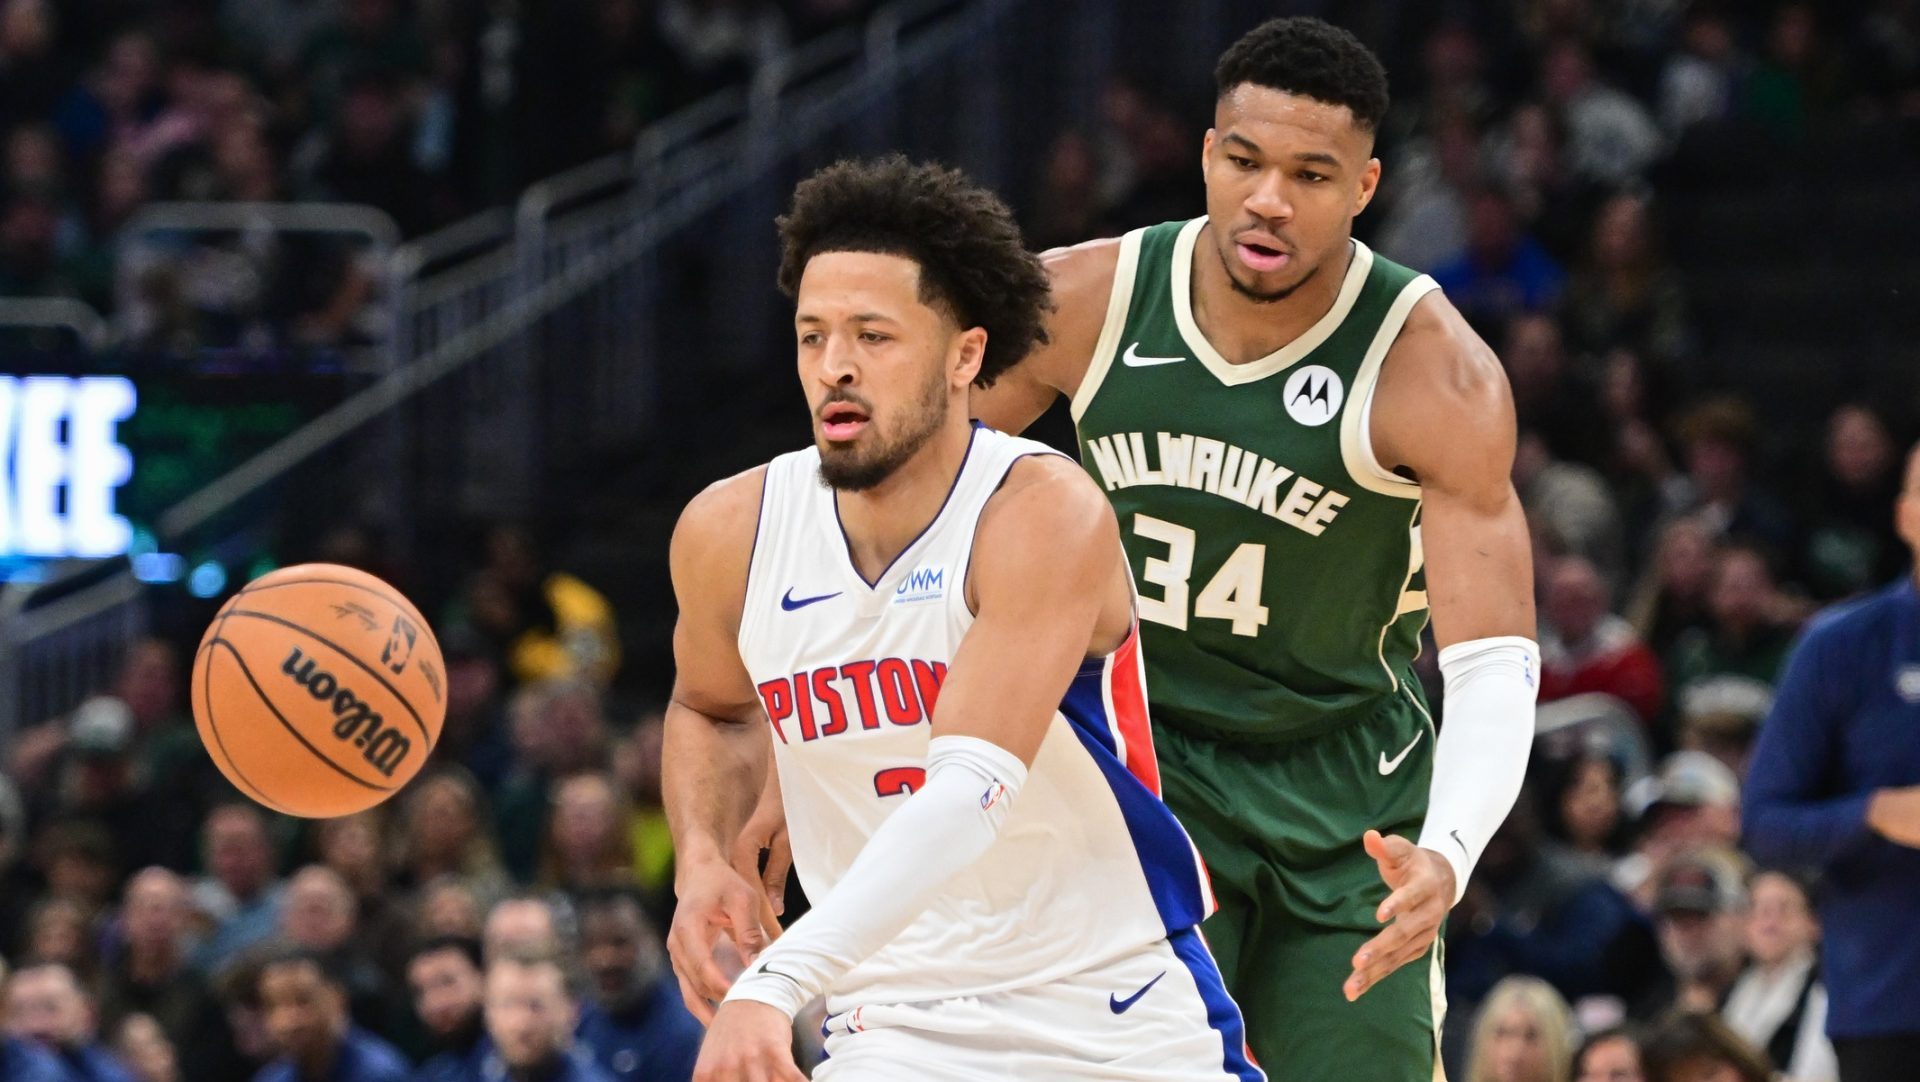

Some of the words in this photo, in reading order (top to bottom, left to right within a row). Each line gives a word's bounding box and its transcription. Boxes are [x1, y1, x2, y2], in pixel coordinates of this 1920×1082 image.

[1087, 431, 1350, 537] MILWAUKEE
[1133, 513, 1269, 637] 34
[281, 646, 411, 777] Wilson
